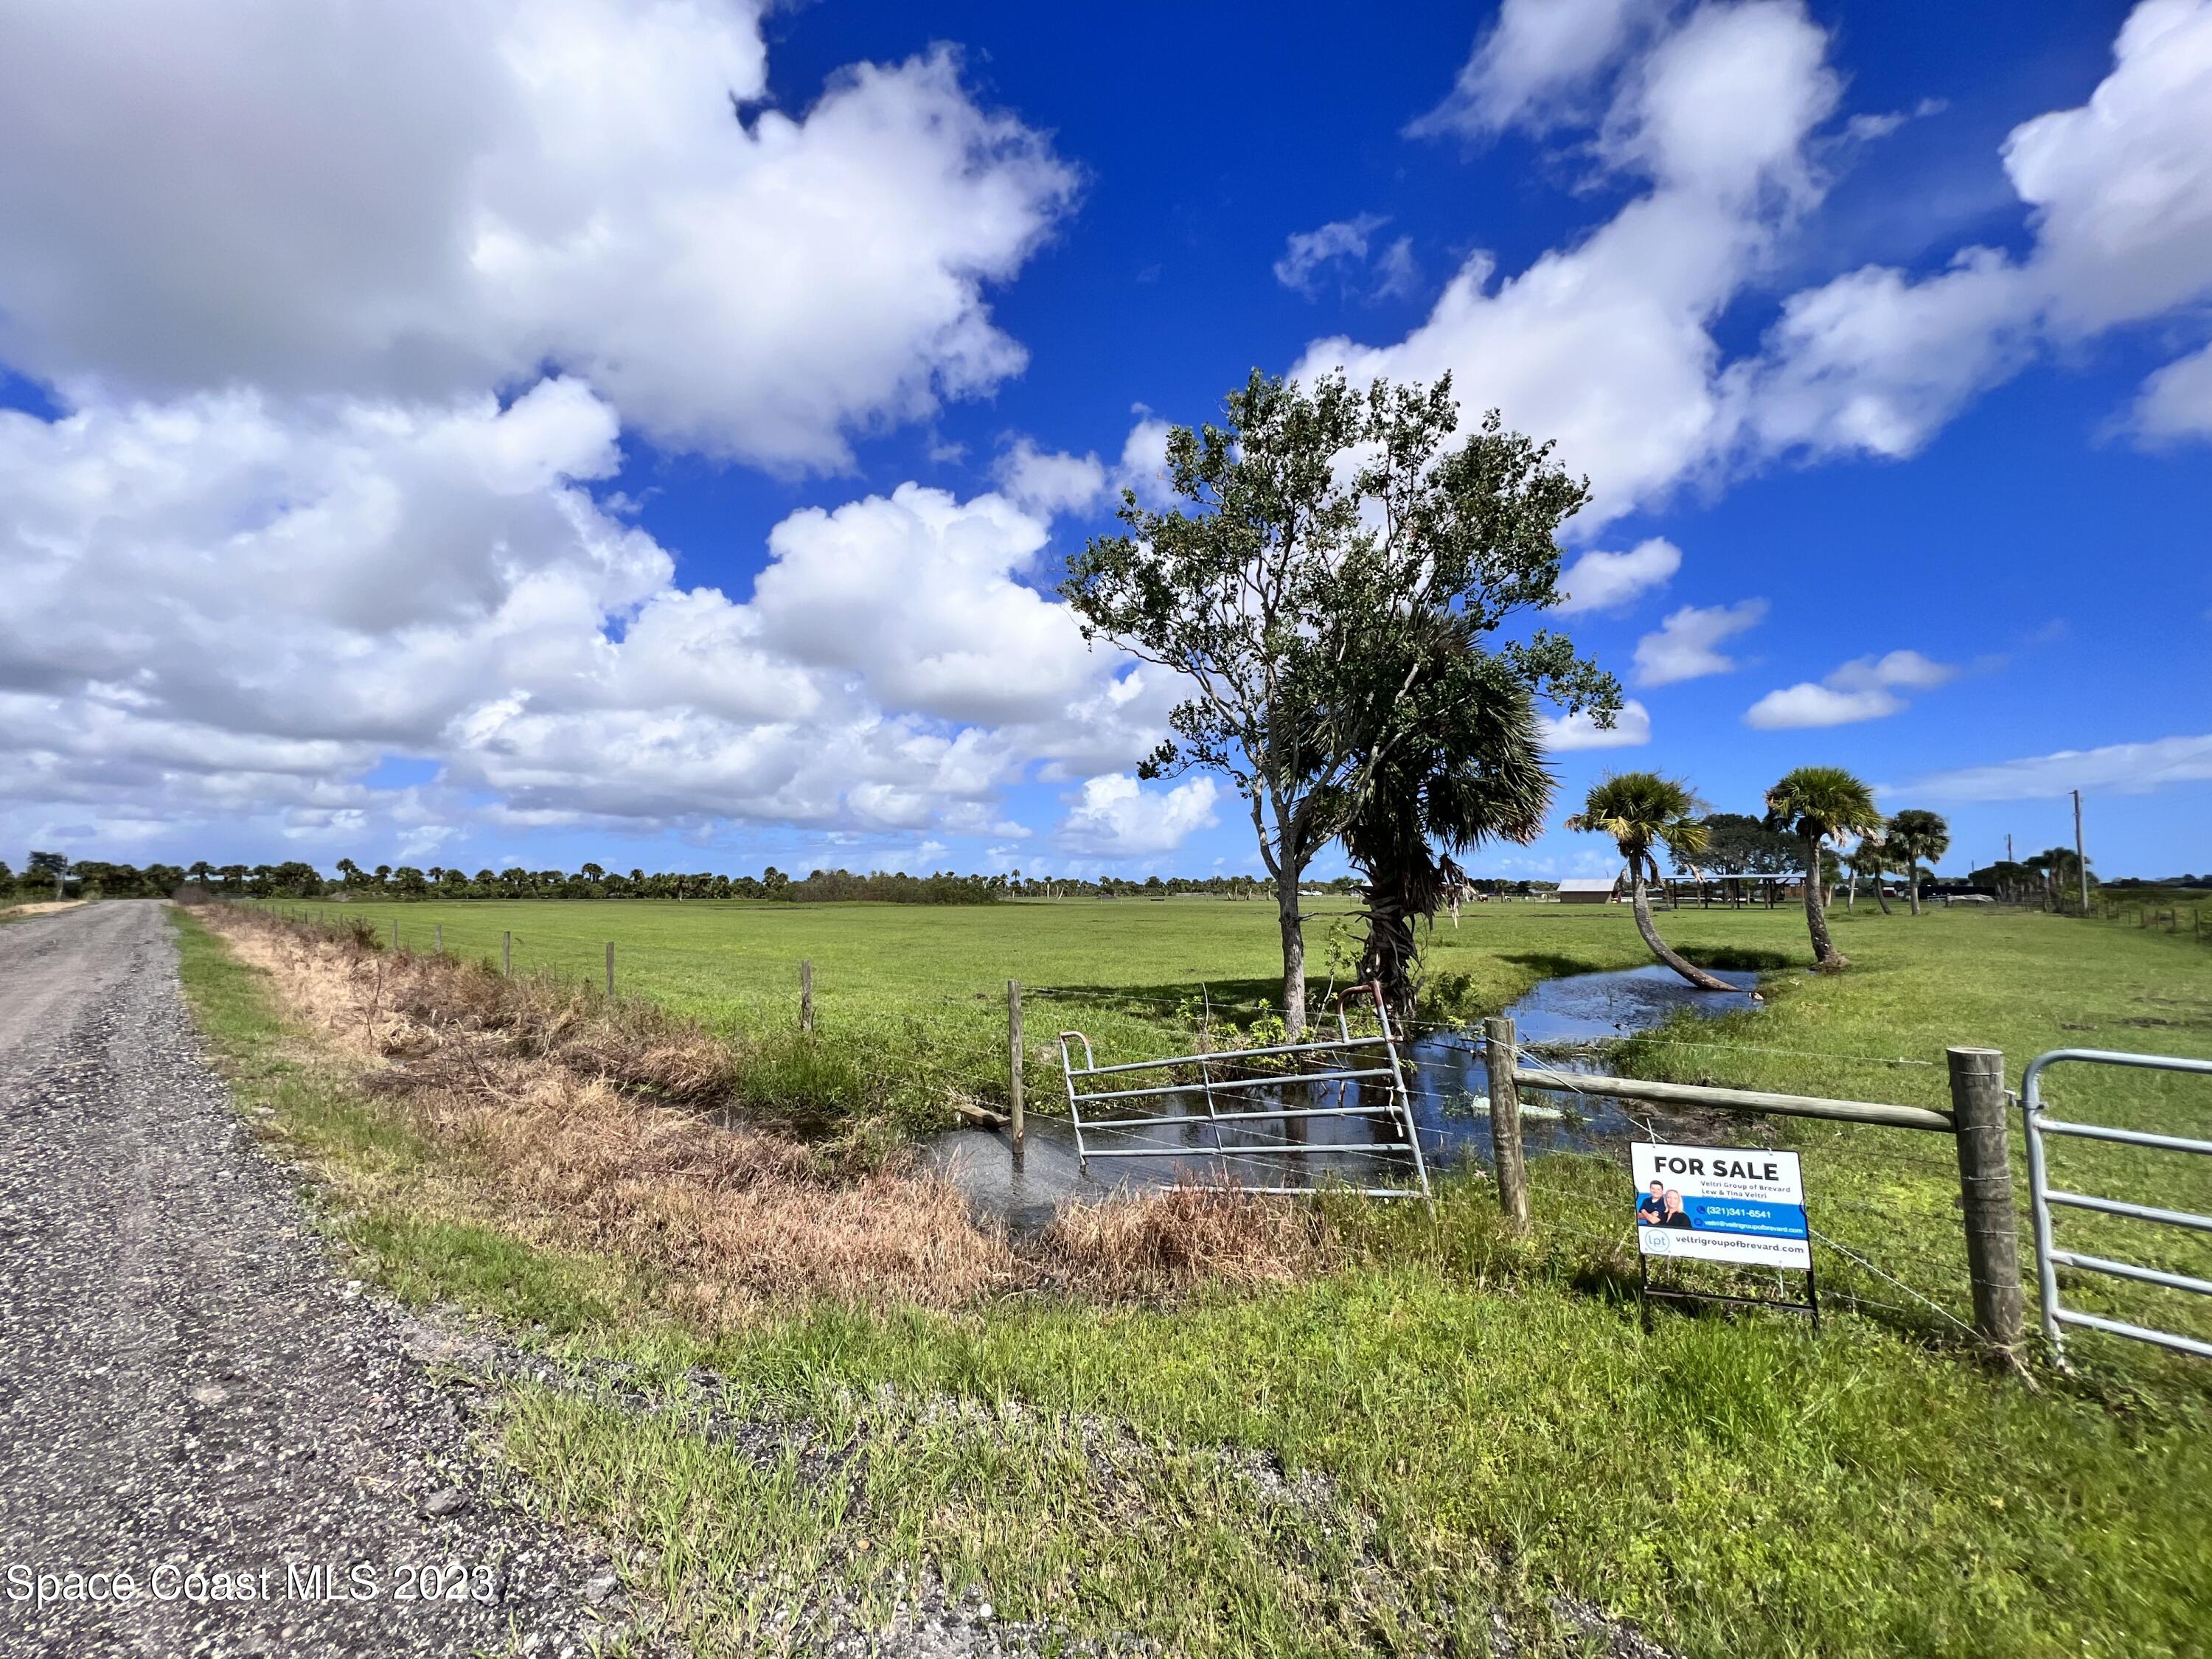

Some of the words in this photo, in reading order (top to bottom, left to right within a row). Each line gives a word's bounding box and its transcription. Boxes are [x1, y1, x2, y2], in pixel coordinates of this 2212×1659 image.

[1655, 1155, 1705, 1176] FOR
[1713, 1160, 1779, 1181] SALE
[1724, 1182, 1747, 1190] Group
[1706, 1206, 1771, 1219] (321)341-6541
[1675, 1236, 1804, 1253] veltrigroupofbrevard.com
